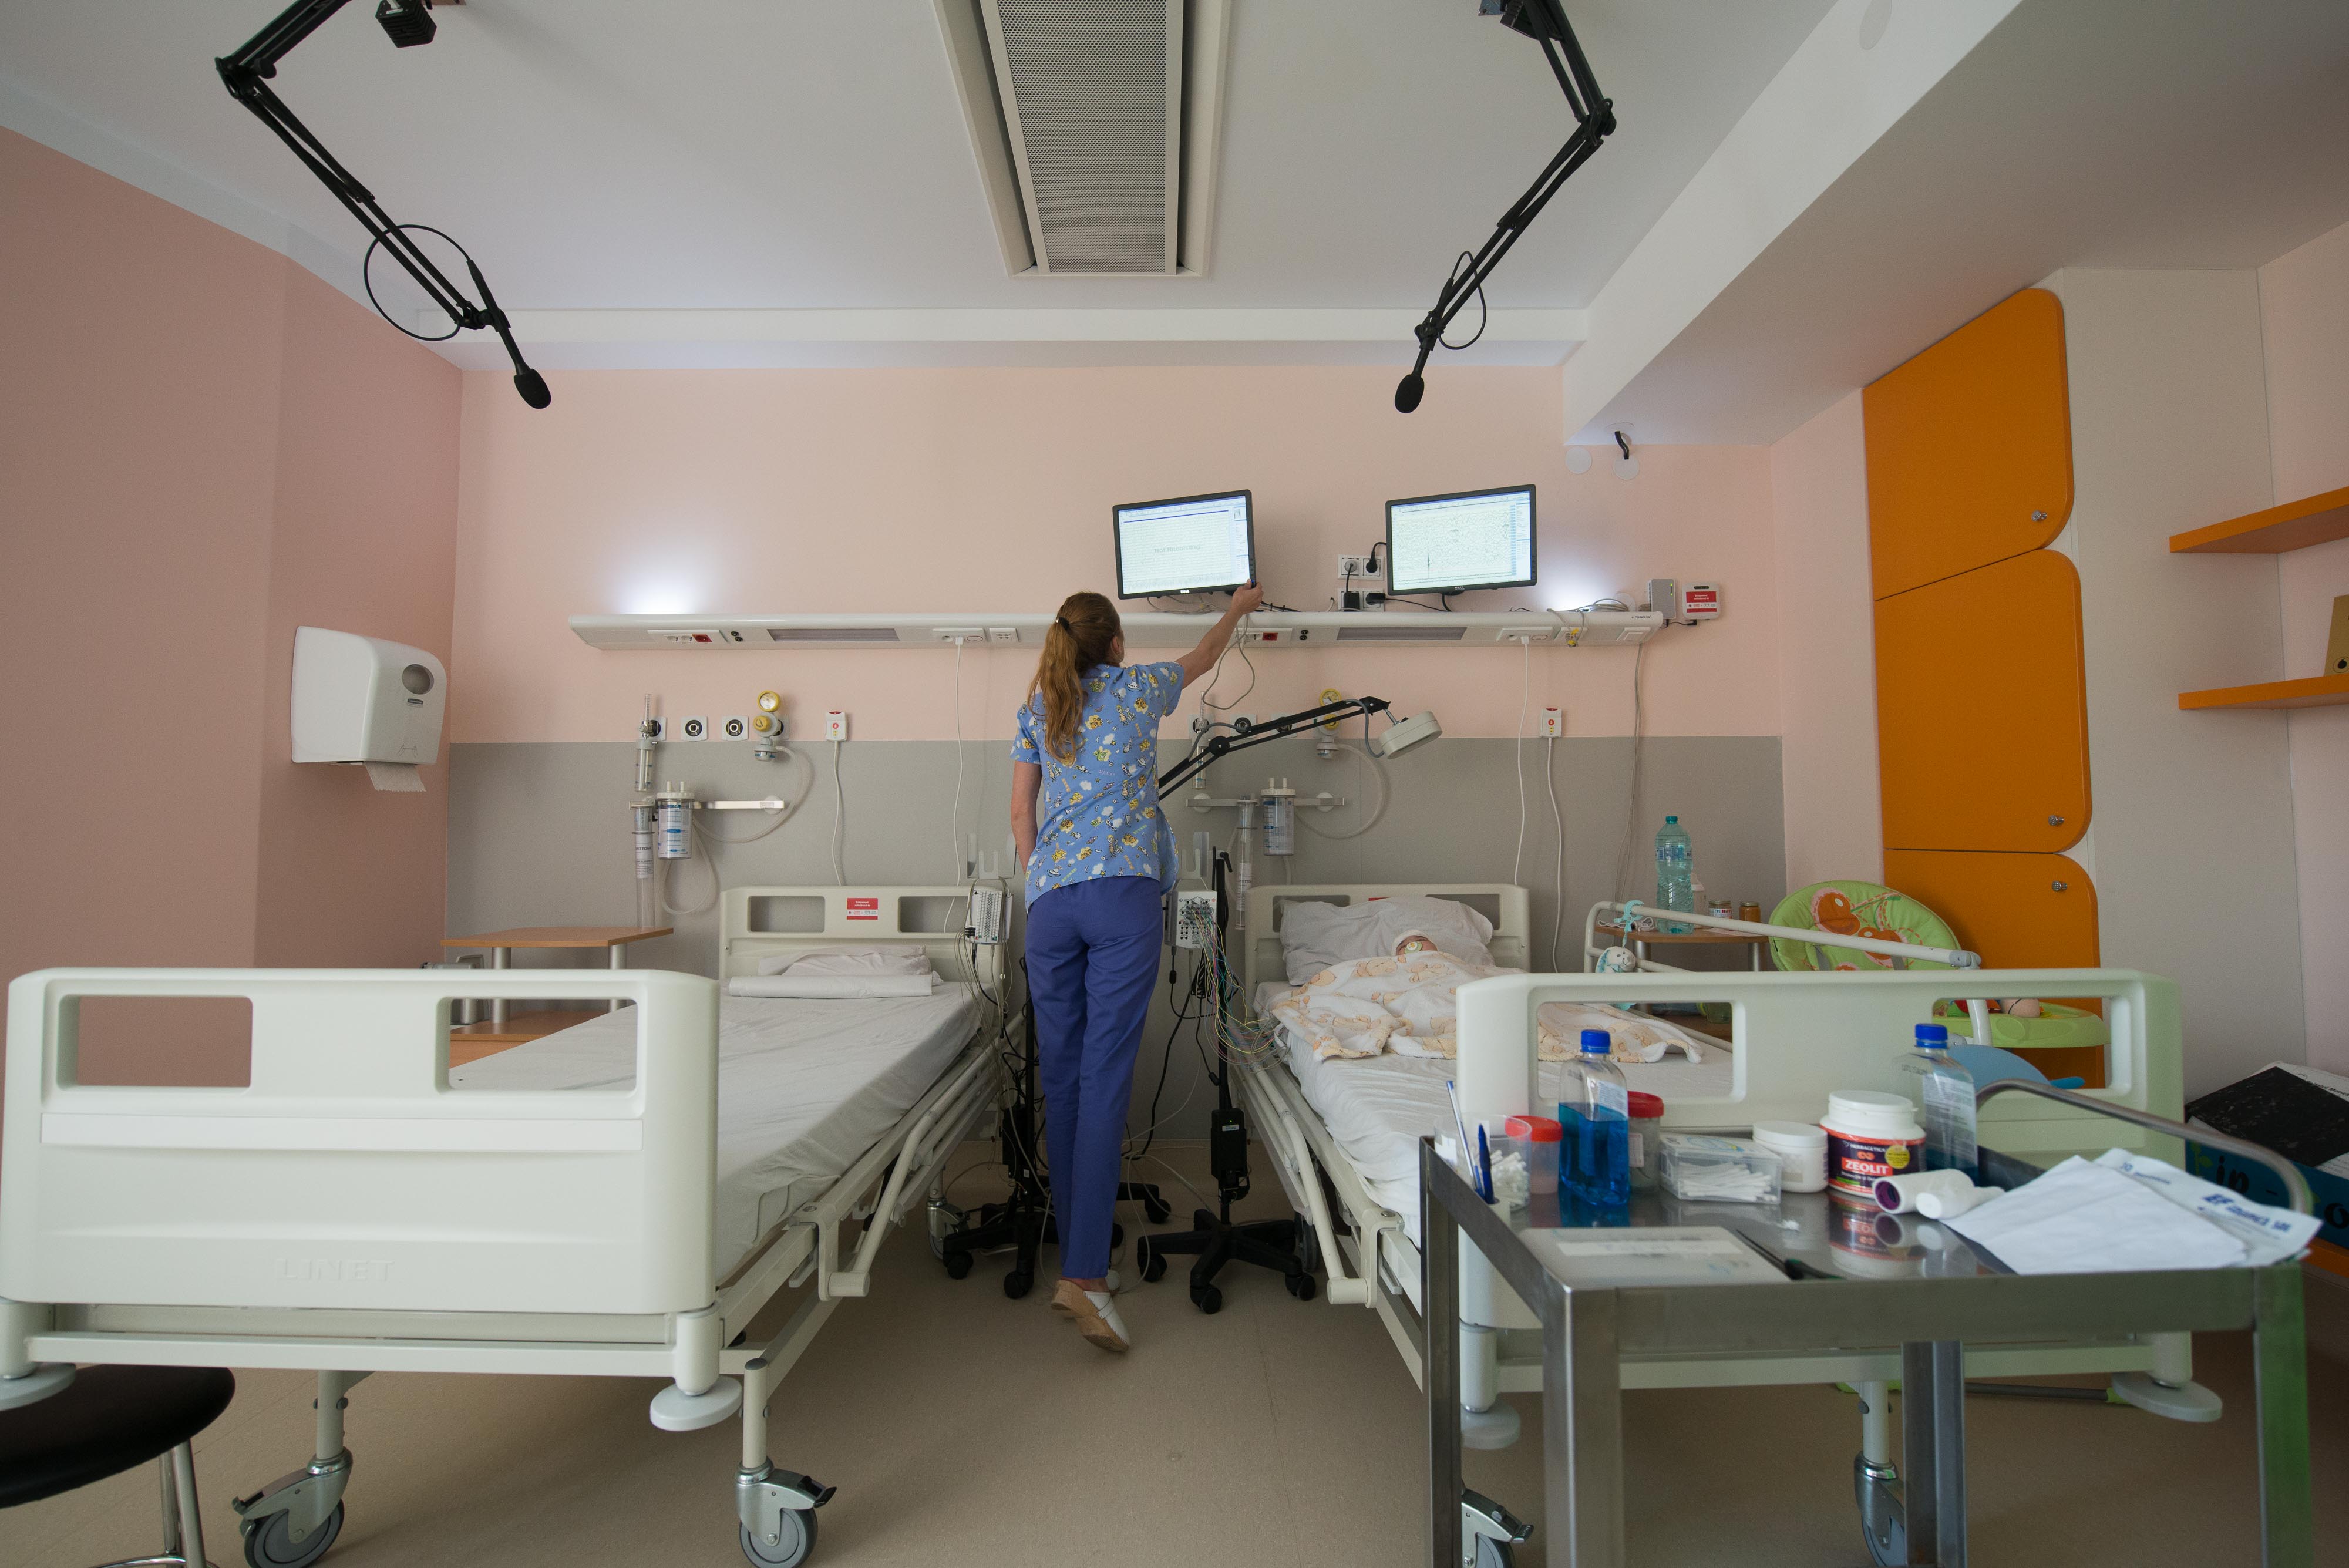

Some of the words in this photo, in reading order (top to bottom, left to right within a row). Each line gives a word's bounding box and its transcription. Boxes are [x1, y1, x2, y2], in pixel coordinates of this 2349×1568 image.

[1167, 544, 1200, 553] Recording
[1850, 1143, 1886, 1152] HERBAGETICA
[1845, 1160, 1889, 1175] ZEOLIT
[275, 1259, 395, 1283] LINET
